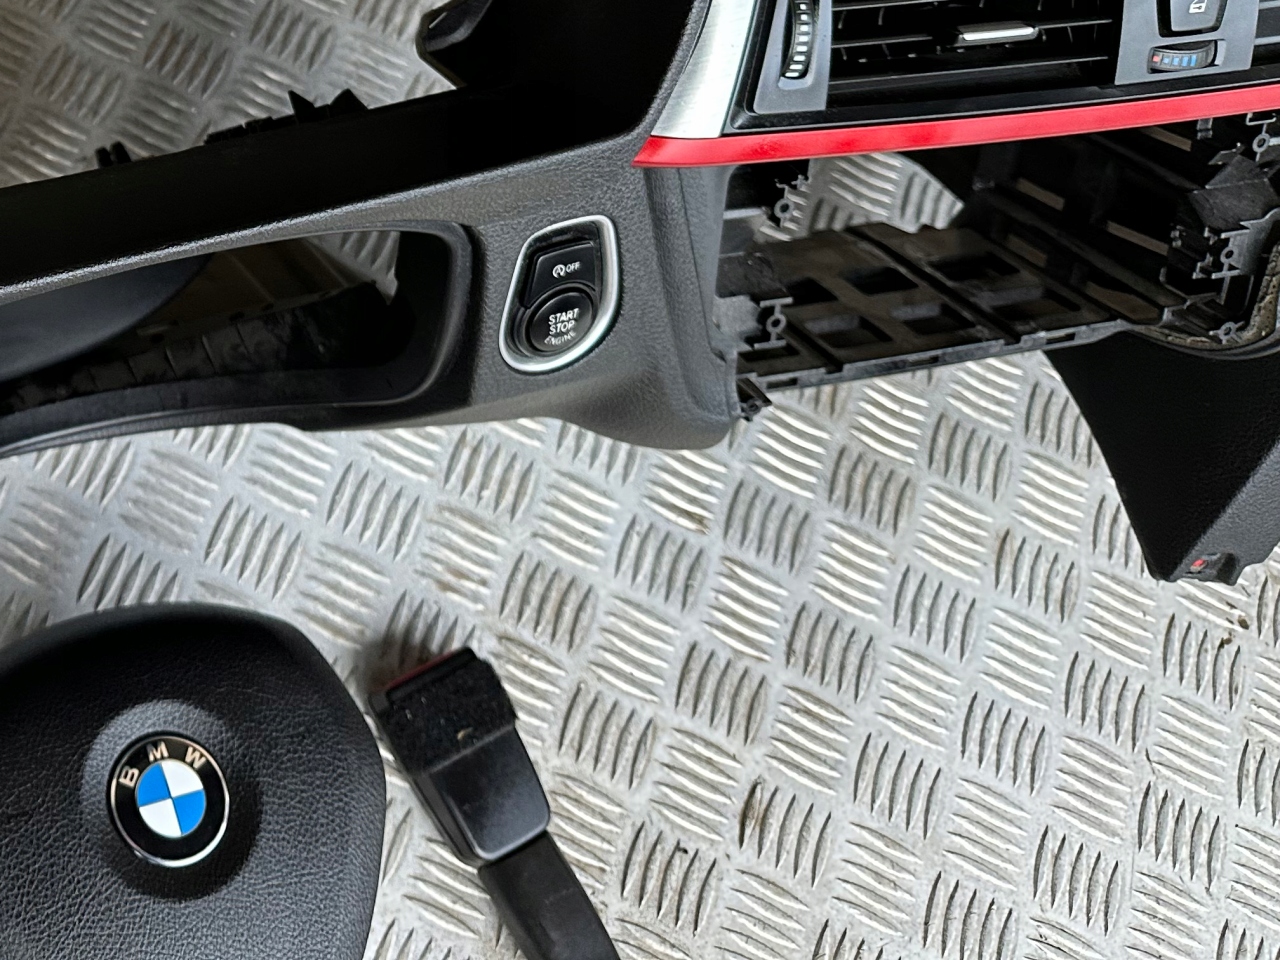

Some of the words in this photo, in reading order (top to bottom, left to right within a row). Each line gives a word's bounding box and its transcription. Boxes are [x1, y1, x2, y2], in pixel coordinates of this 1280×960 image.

[566, 261, 581, 273] OFF
[548, 307, 580, 325] START
[549, 320, 575, 335] STOP
[119, 741, 207, 788] BMW
